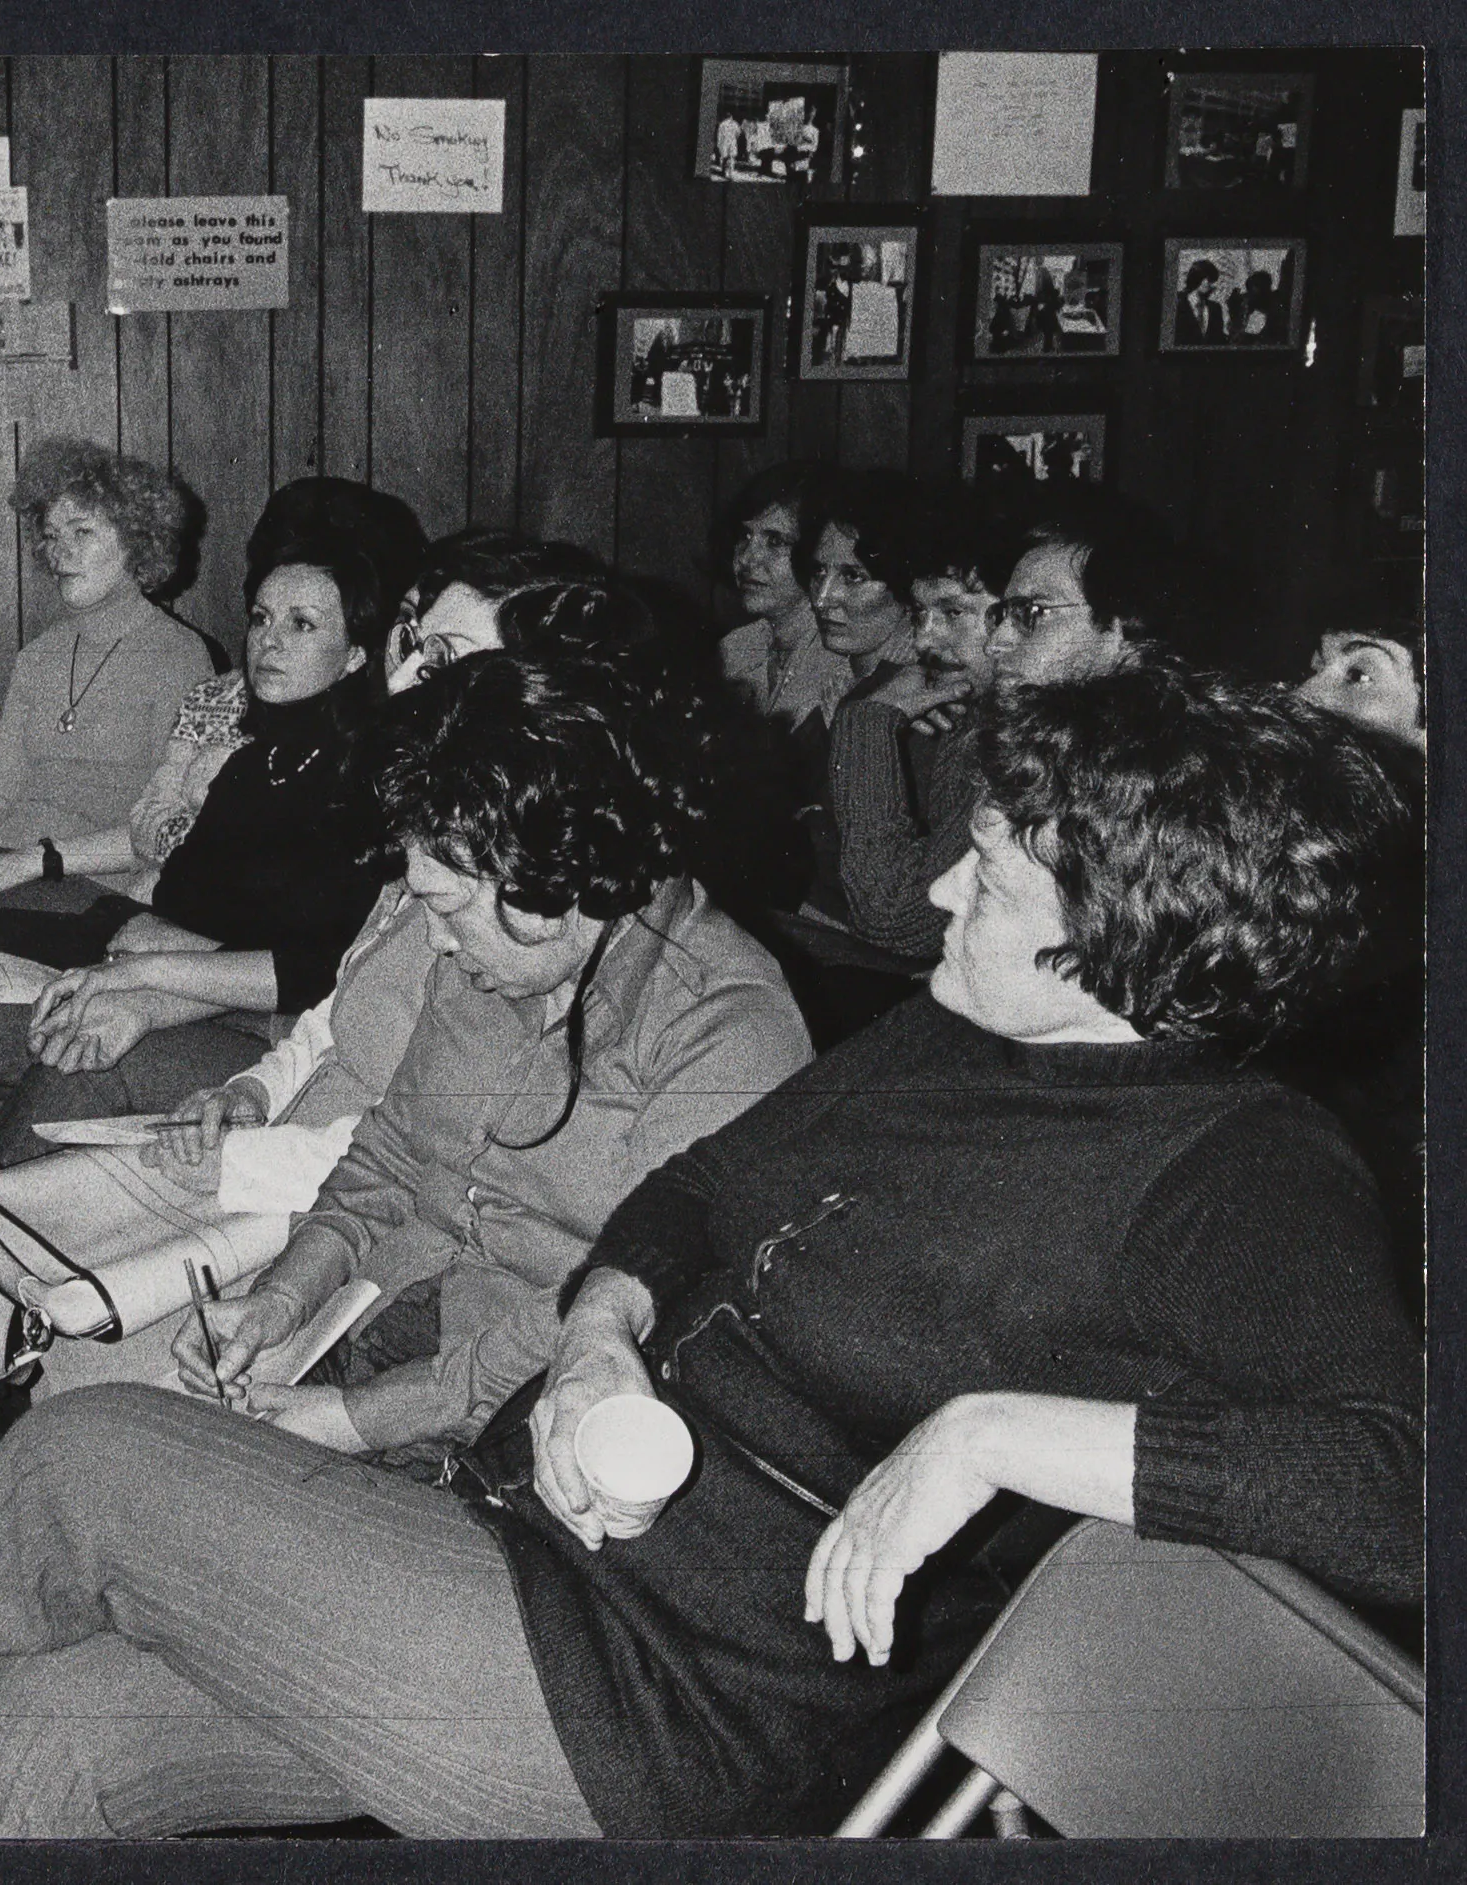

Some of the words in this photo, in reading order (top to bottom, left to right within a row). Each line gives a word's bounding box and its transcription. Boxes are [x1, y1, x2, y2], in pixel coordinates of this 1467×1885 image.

[194, 213, 238, 228] leave
[245, 213, 276, 228] this
[171, 235, 190, 246] as
[201, 235, 232, 249] you
[238, 231, 283, 246] found
[183, 251, 236, 266] chairs
[244, 251, 277, 265] and
[172, 274, 240, 289] ashtrays
